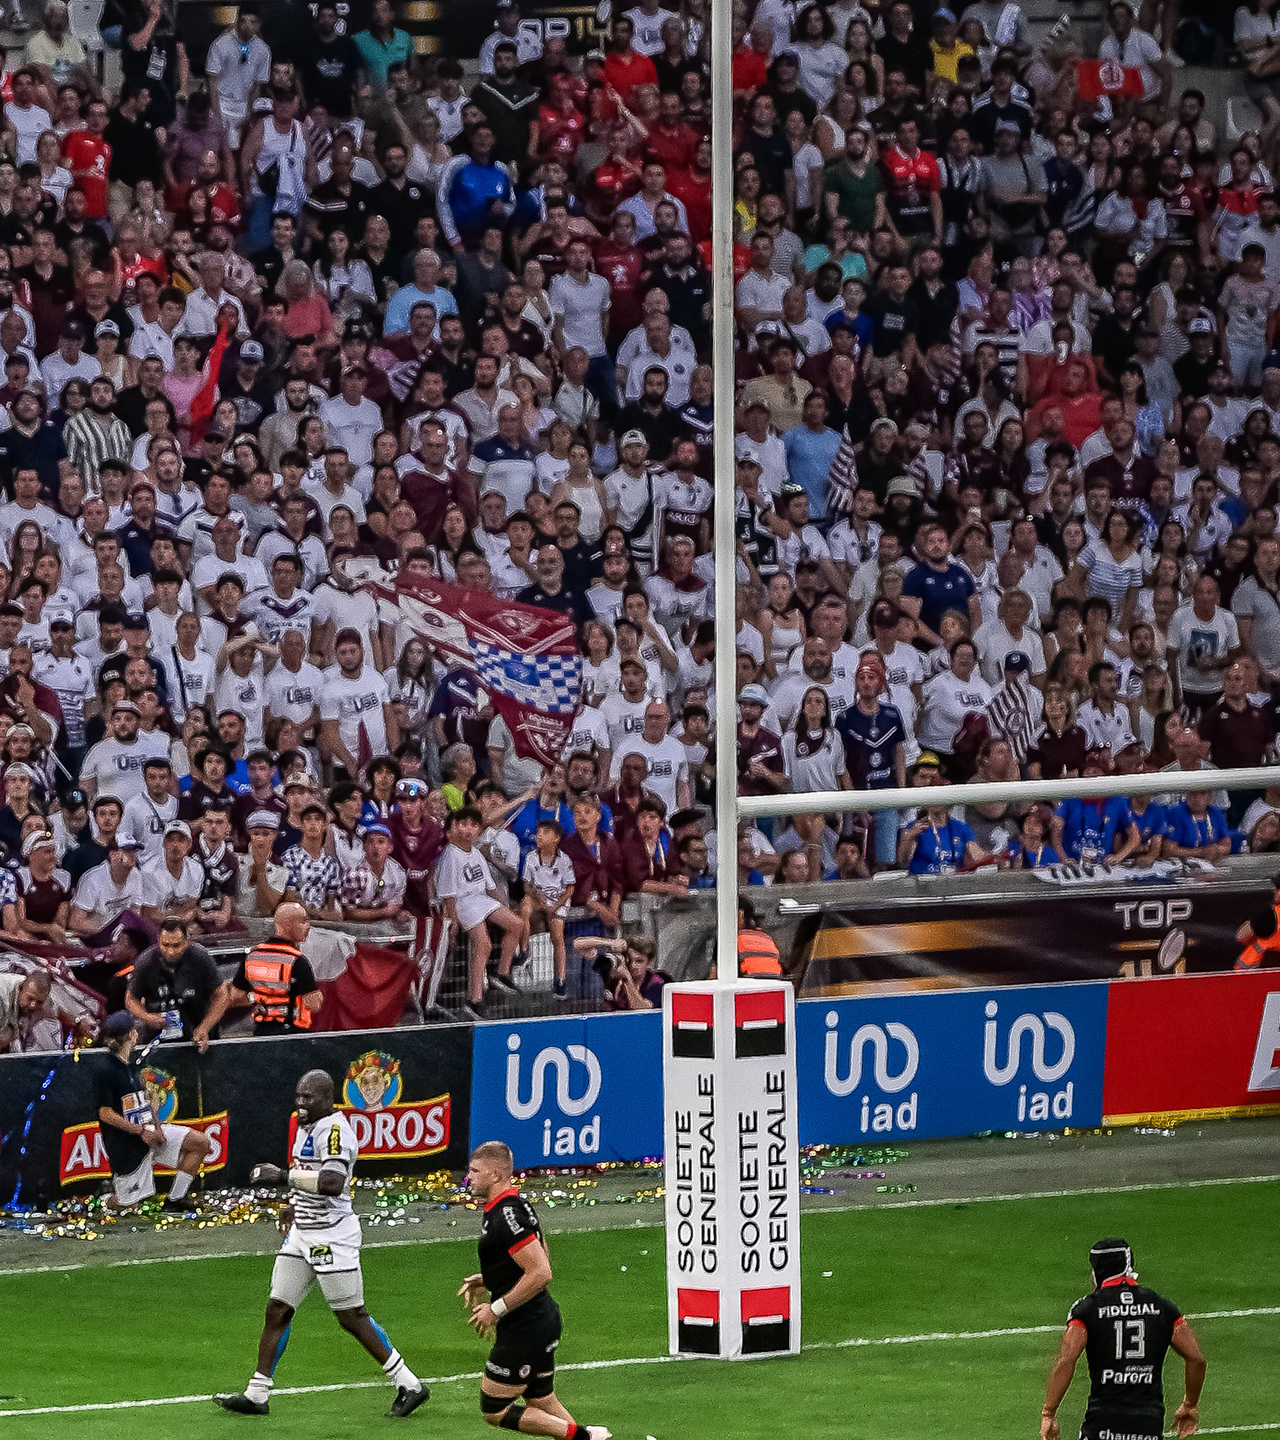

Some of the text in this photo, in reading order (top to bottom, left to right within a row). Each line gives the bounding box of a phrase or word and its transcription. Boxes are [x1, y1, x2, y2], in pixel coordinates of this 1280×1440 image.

[1114, 899, 1193, 930] TOP
[861, 1092, 918, 1133] iad
[1018, 1081, 1074, 1122] iad
[349, 1106, 445, 1149] DROS
[543, 1115, 601, 1158] iad
[698, 1073, 718, 1274] GENERALE
[766, 1069, 788, 1271] GENERALE
[675, 1110, 694, 1273] SOCIETE
[739, 1110, 760, 1274] SOCIETE
[1098, 1304, 1160, 1319] FIDUCIAL
[1114, 1319, 1145, 1360] 13
[1101, 1369, 1153, 1385] Parera
